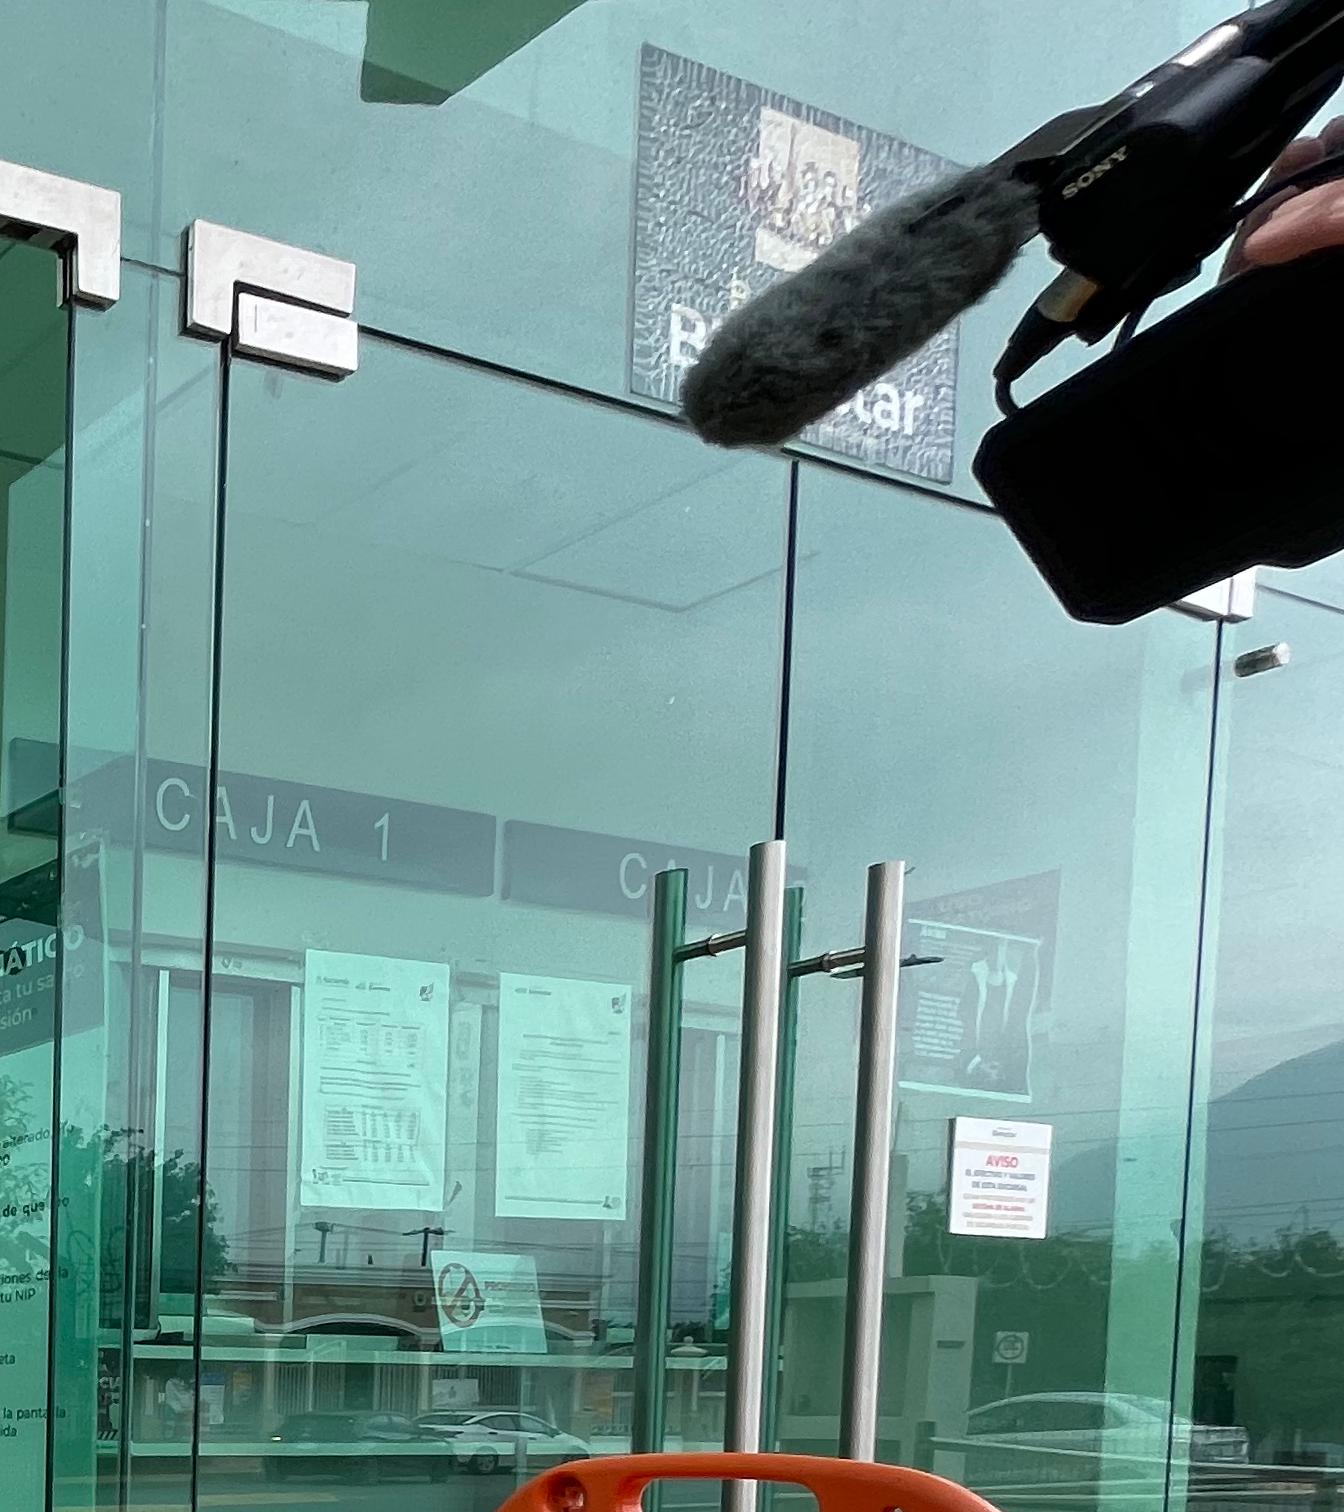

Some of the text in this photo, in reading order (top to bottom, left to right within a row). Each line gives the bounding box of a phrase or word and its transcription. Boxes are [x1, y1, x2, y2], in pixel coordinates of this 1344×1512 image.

[1062, 145, 1128, 200] SONY
[156, 777, 390, 861] CAJA 1
[619, 853, 746, 912] CJA
[15, 982, 32, 999] tu
[986, 1155, 1018, 1168] AVISO
[2, 1204, 17, 1218] de
[22, 1201, 45, 1217] que
[0, 1293, 13, 1303] tu
[15, 1287, 36, 1302] NIP
[3, 1407, 13, 1419] la
